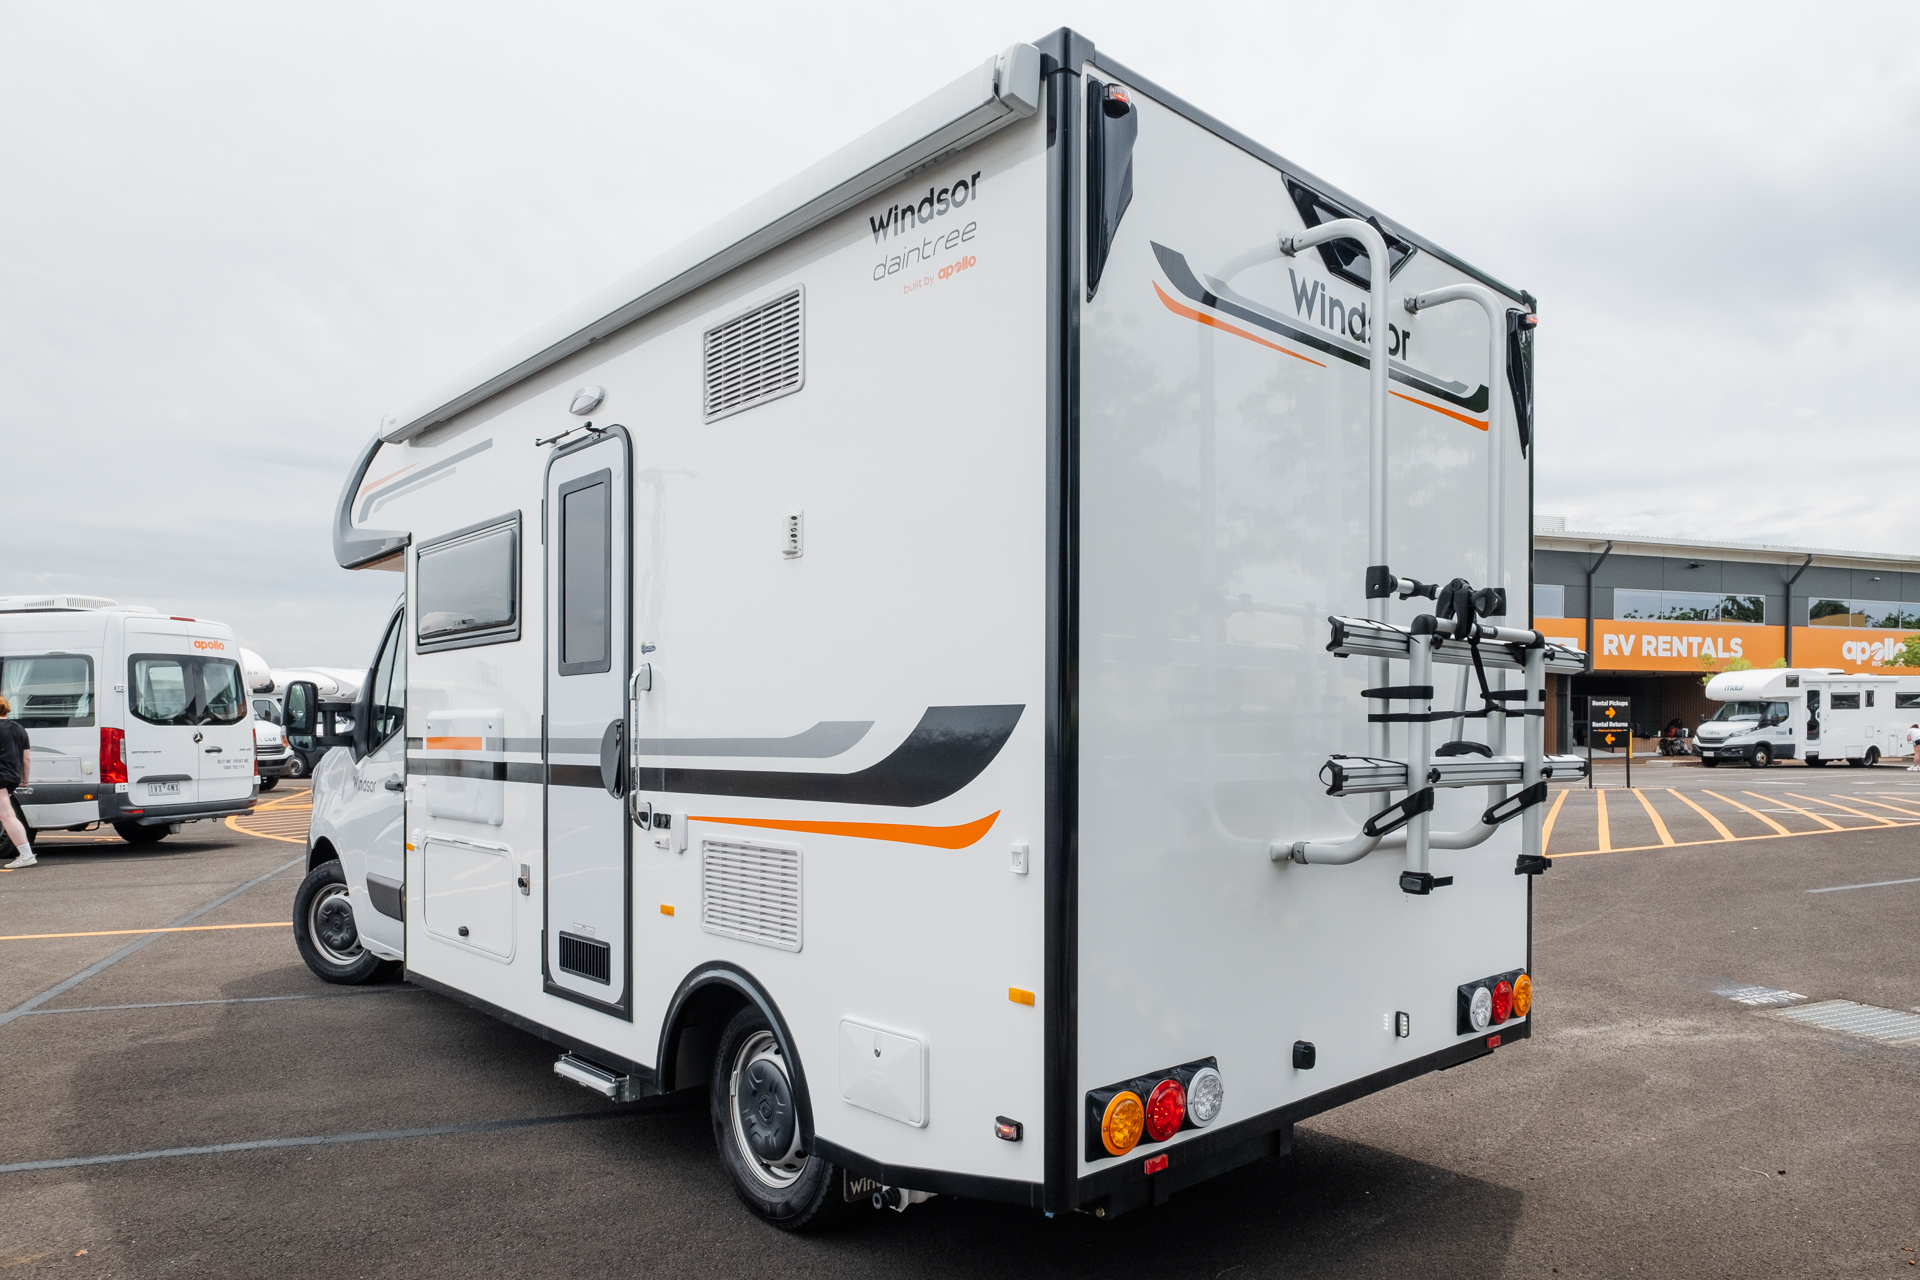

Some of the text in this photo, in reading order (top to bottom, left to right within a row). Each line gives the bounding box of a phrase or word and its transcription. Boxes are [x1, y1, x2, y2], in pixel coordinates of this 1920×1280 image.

[869, 170, 981, 246] Windsor
[873, 221, 977, 281] daintree
[903, 255, 977, 294] built by apollo
[1288, 267, 1411, 361] Windor
[193, 640, 225, 651] apollo
[1603, 634, 1743, 659] RV RENTALS
[850, 1177, 883, 1195] Win
